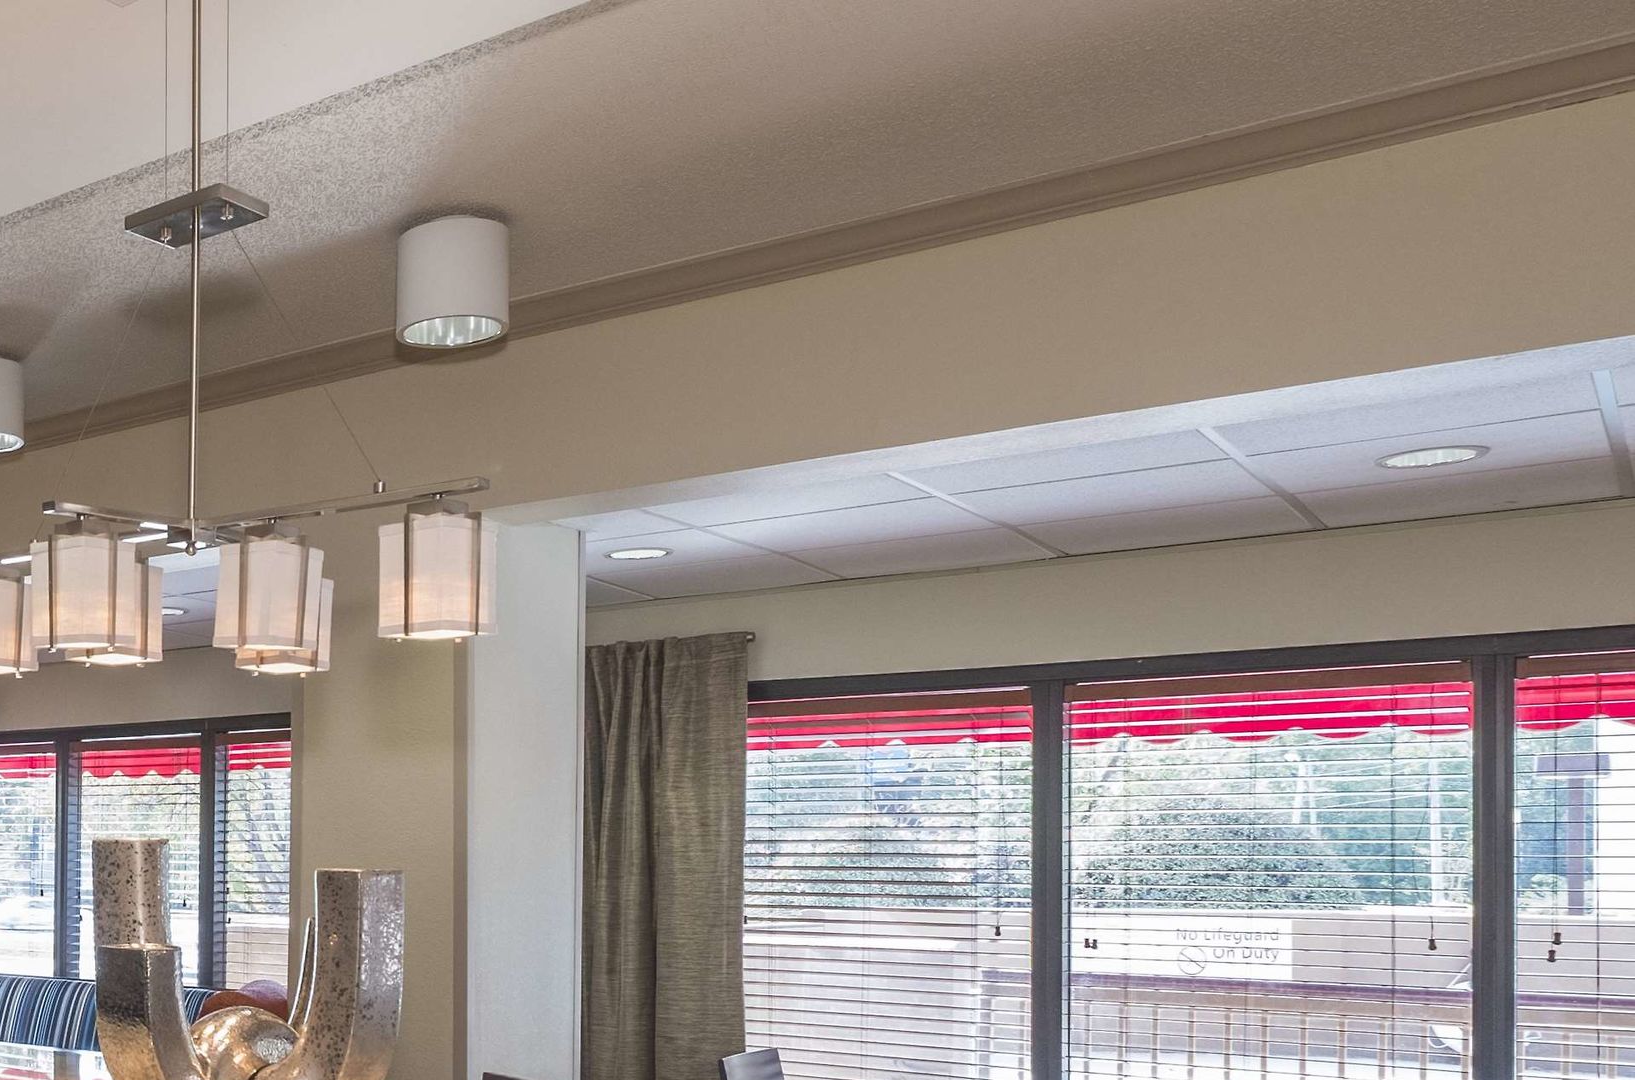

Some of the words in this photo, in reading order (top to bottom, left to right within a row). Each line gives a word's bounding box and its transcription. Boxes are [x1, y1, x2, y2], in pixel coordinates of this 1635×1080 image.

[1175, 928, 1198, 941] No
[1212, 947, 1236, 960] On
[1241, 947, 1280, 963] Duty
